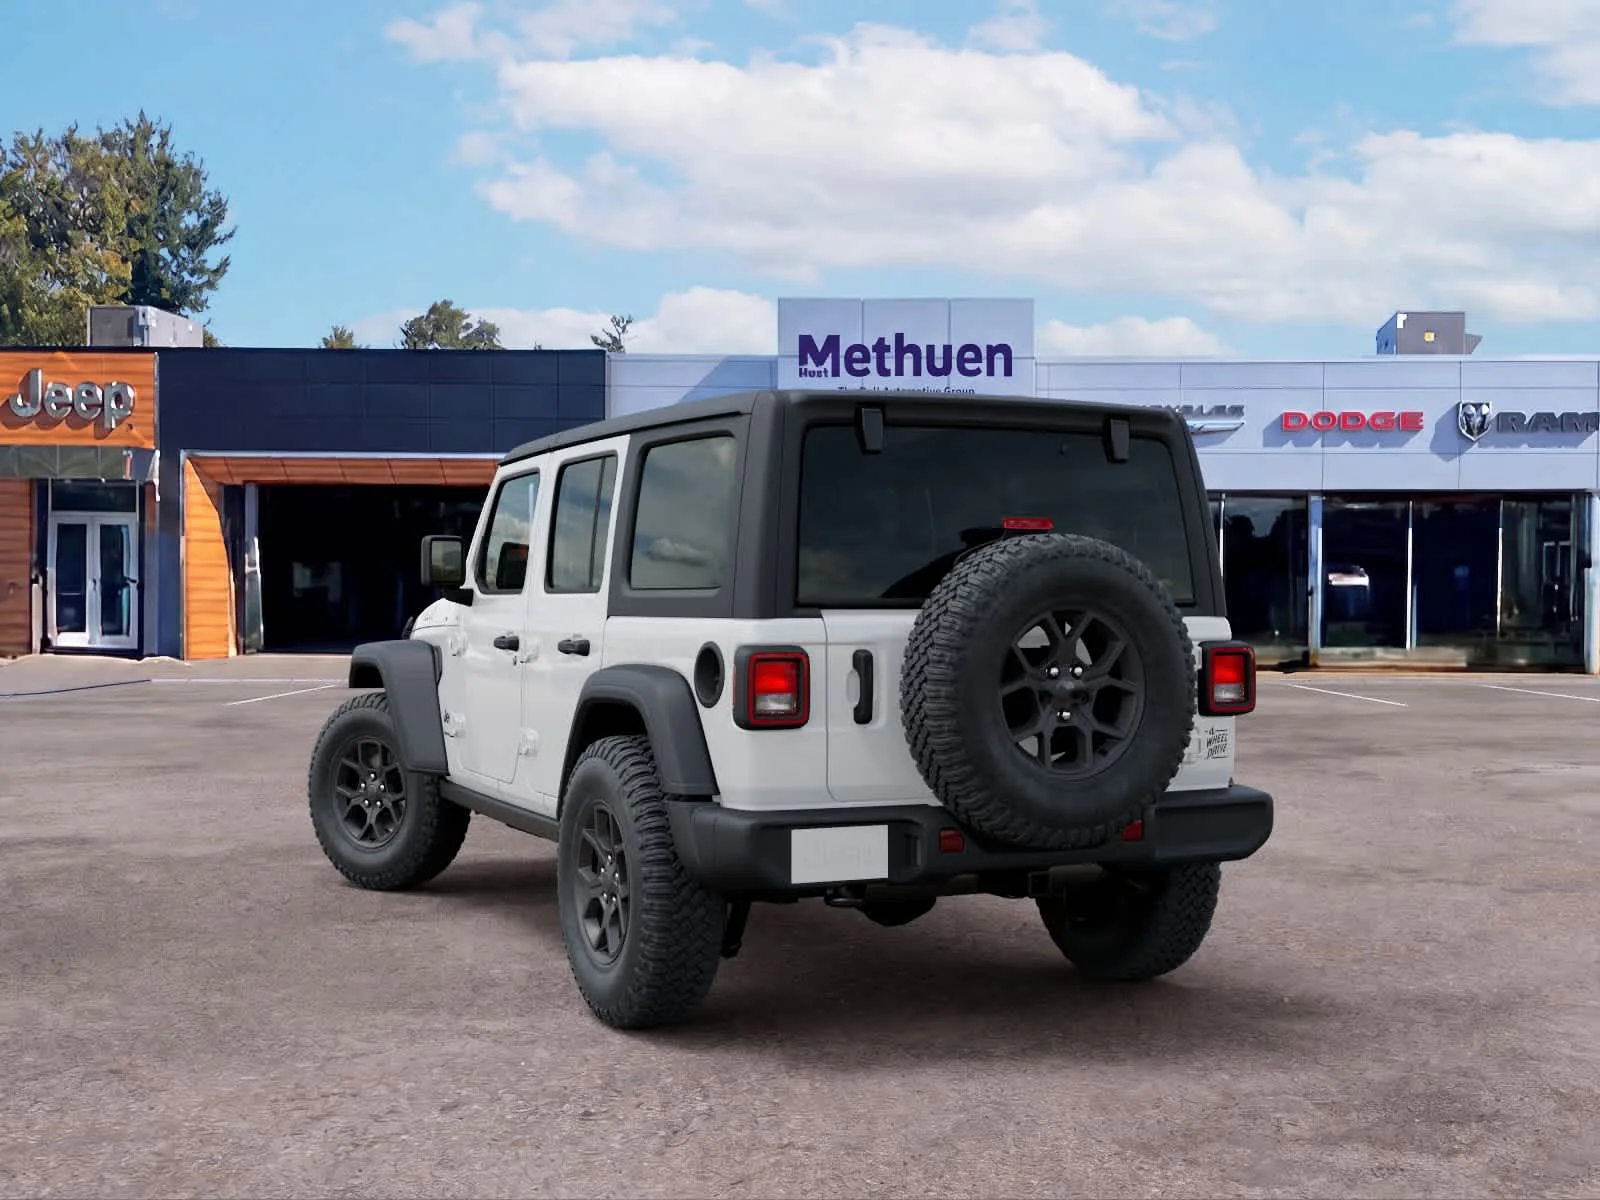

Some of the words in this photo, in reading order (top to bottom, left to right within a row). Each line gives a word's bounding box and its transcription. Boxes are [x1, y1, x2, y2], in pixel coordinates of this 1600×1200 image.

[798, 333, 1013, 378] Methuen
[9, 368, 136, 429] Jeep
[1282, 410, 1425, 432] DODGE
[1497, 411, 1600, 433] RAM
